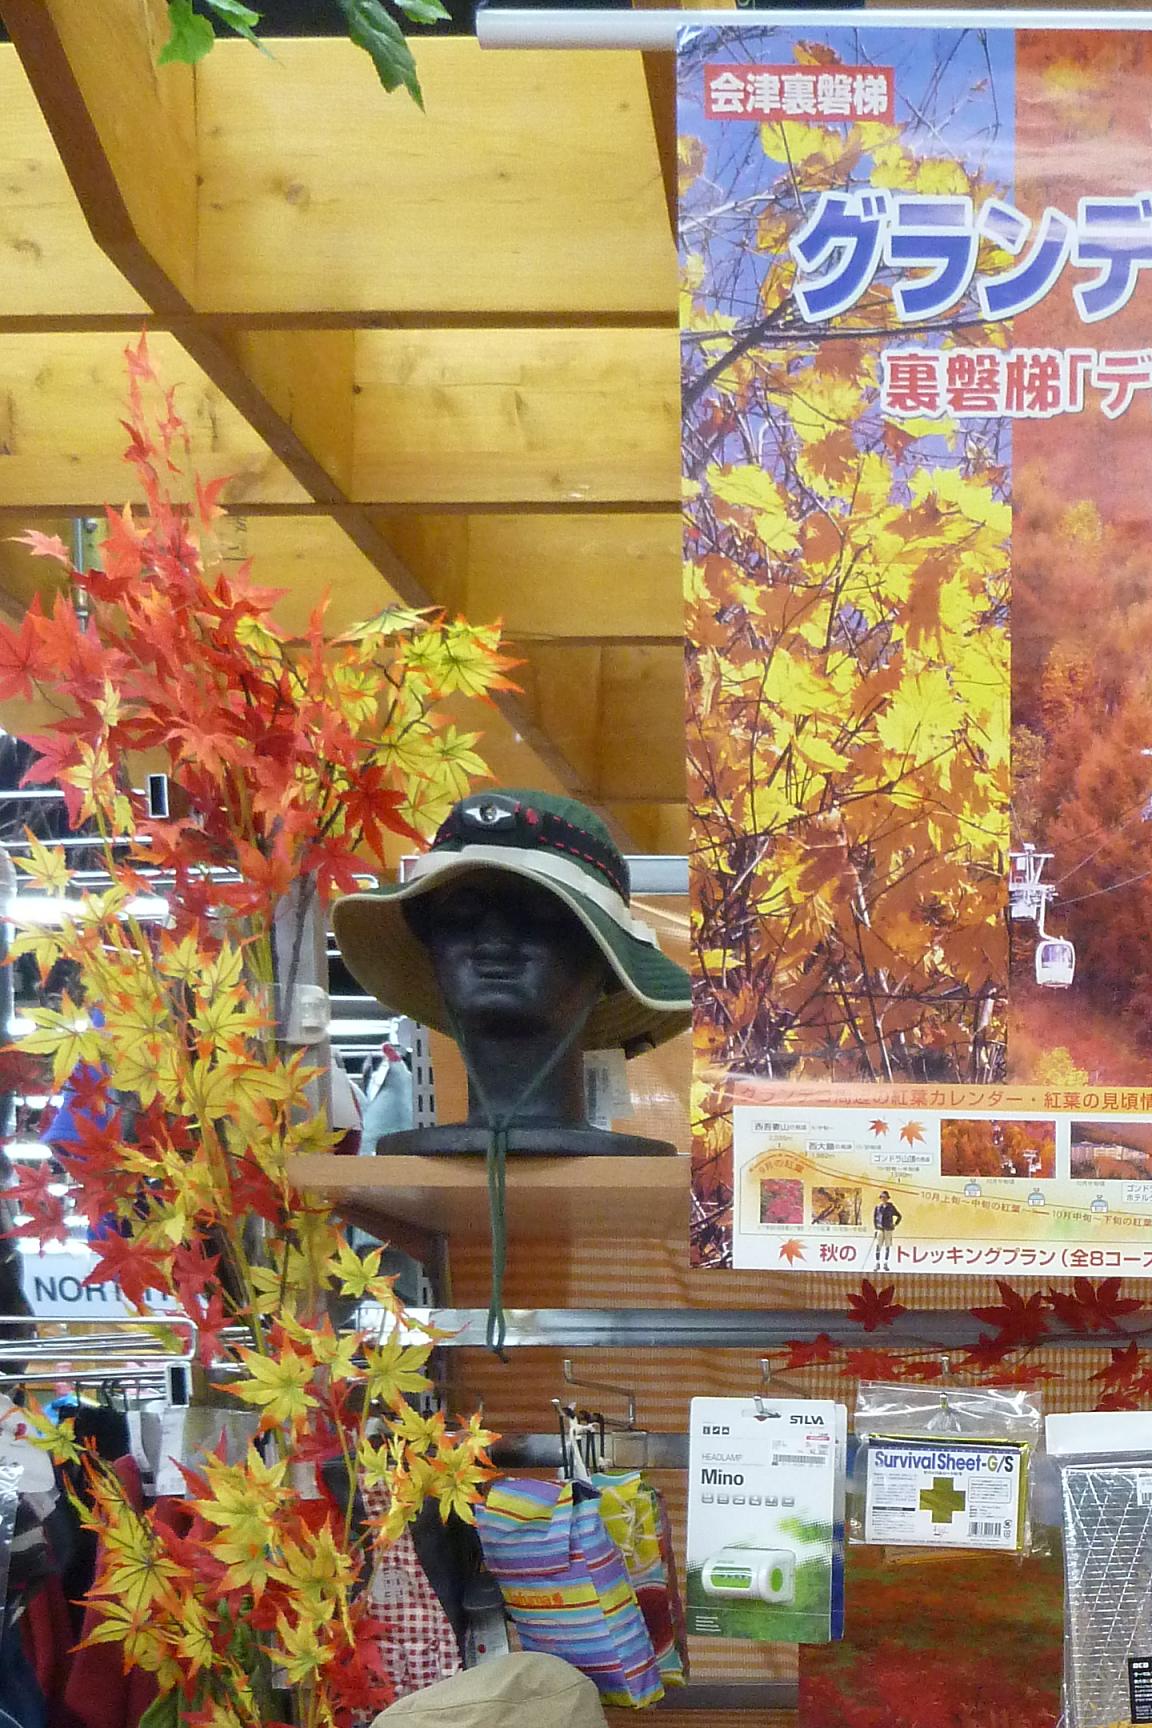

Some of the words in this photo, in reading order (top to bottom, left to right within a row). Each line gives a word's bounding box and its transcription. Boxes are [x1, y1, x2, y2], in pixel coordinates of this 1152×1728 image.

[709, 72, 888, 116] 会津裏磐梯
[819, 1243, 857, 1262] 秋の
[789, 1415, 825, 1425] SILVA
[701, 1453, 743, 1462] HEADLAMP
[701, 1468, 745, 1486] Mino
